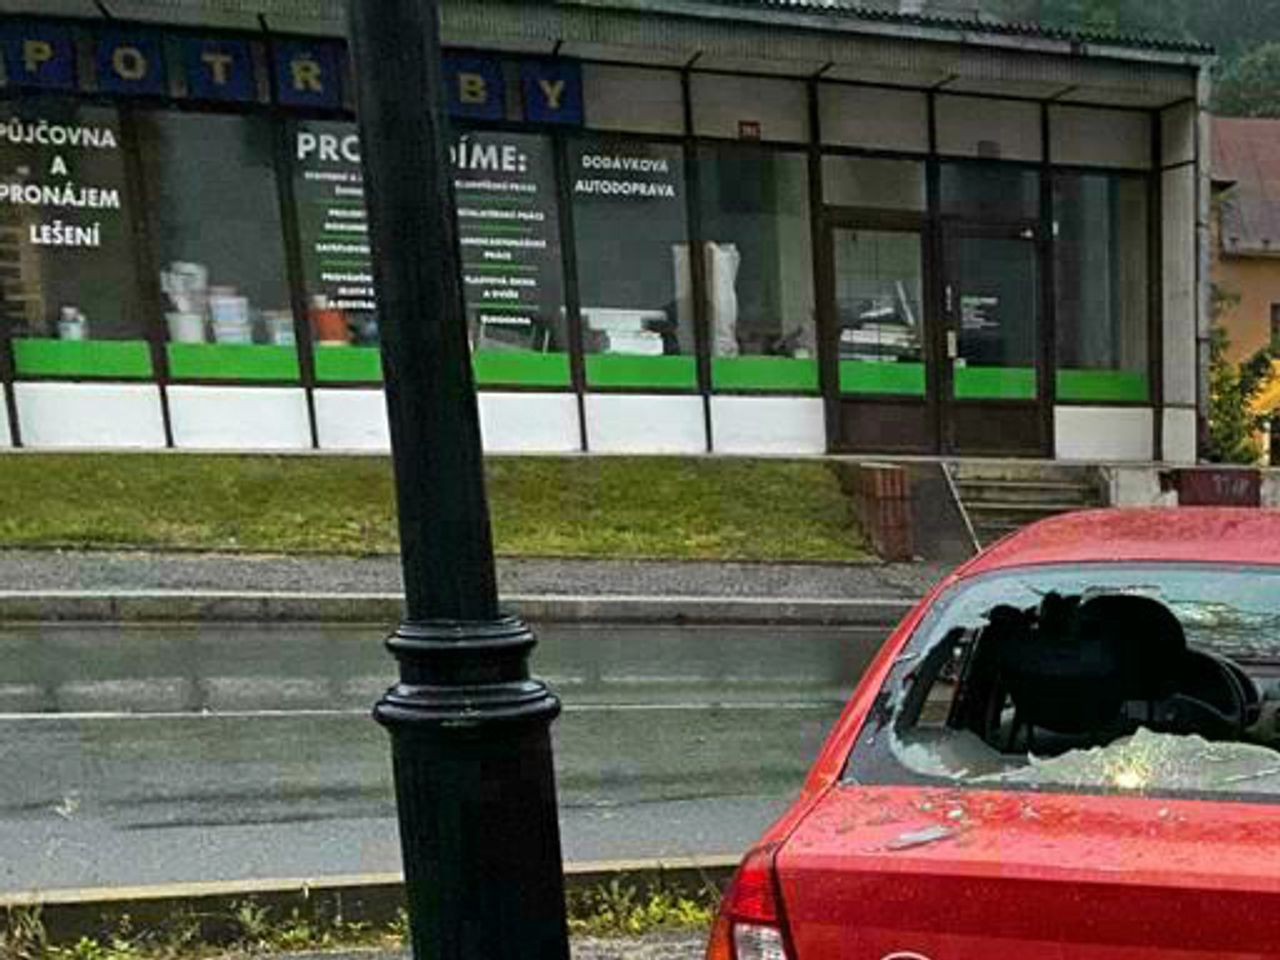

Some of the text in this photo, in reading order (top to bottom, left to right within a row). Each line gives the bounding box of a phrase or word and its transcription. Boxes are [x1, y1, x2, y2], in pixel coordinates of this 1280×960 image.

[23, 40, 566, 110] POTŘBY
[51, 155, 68, 176] A
[574, 179, 676, 198] AUTODOPRAVA
[29, 219, 101, 247] LEŠENÍ
